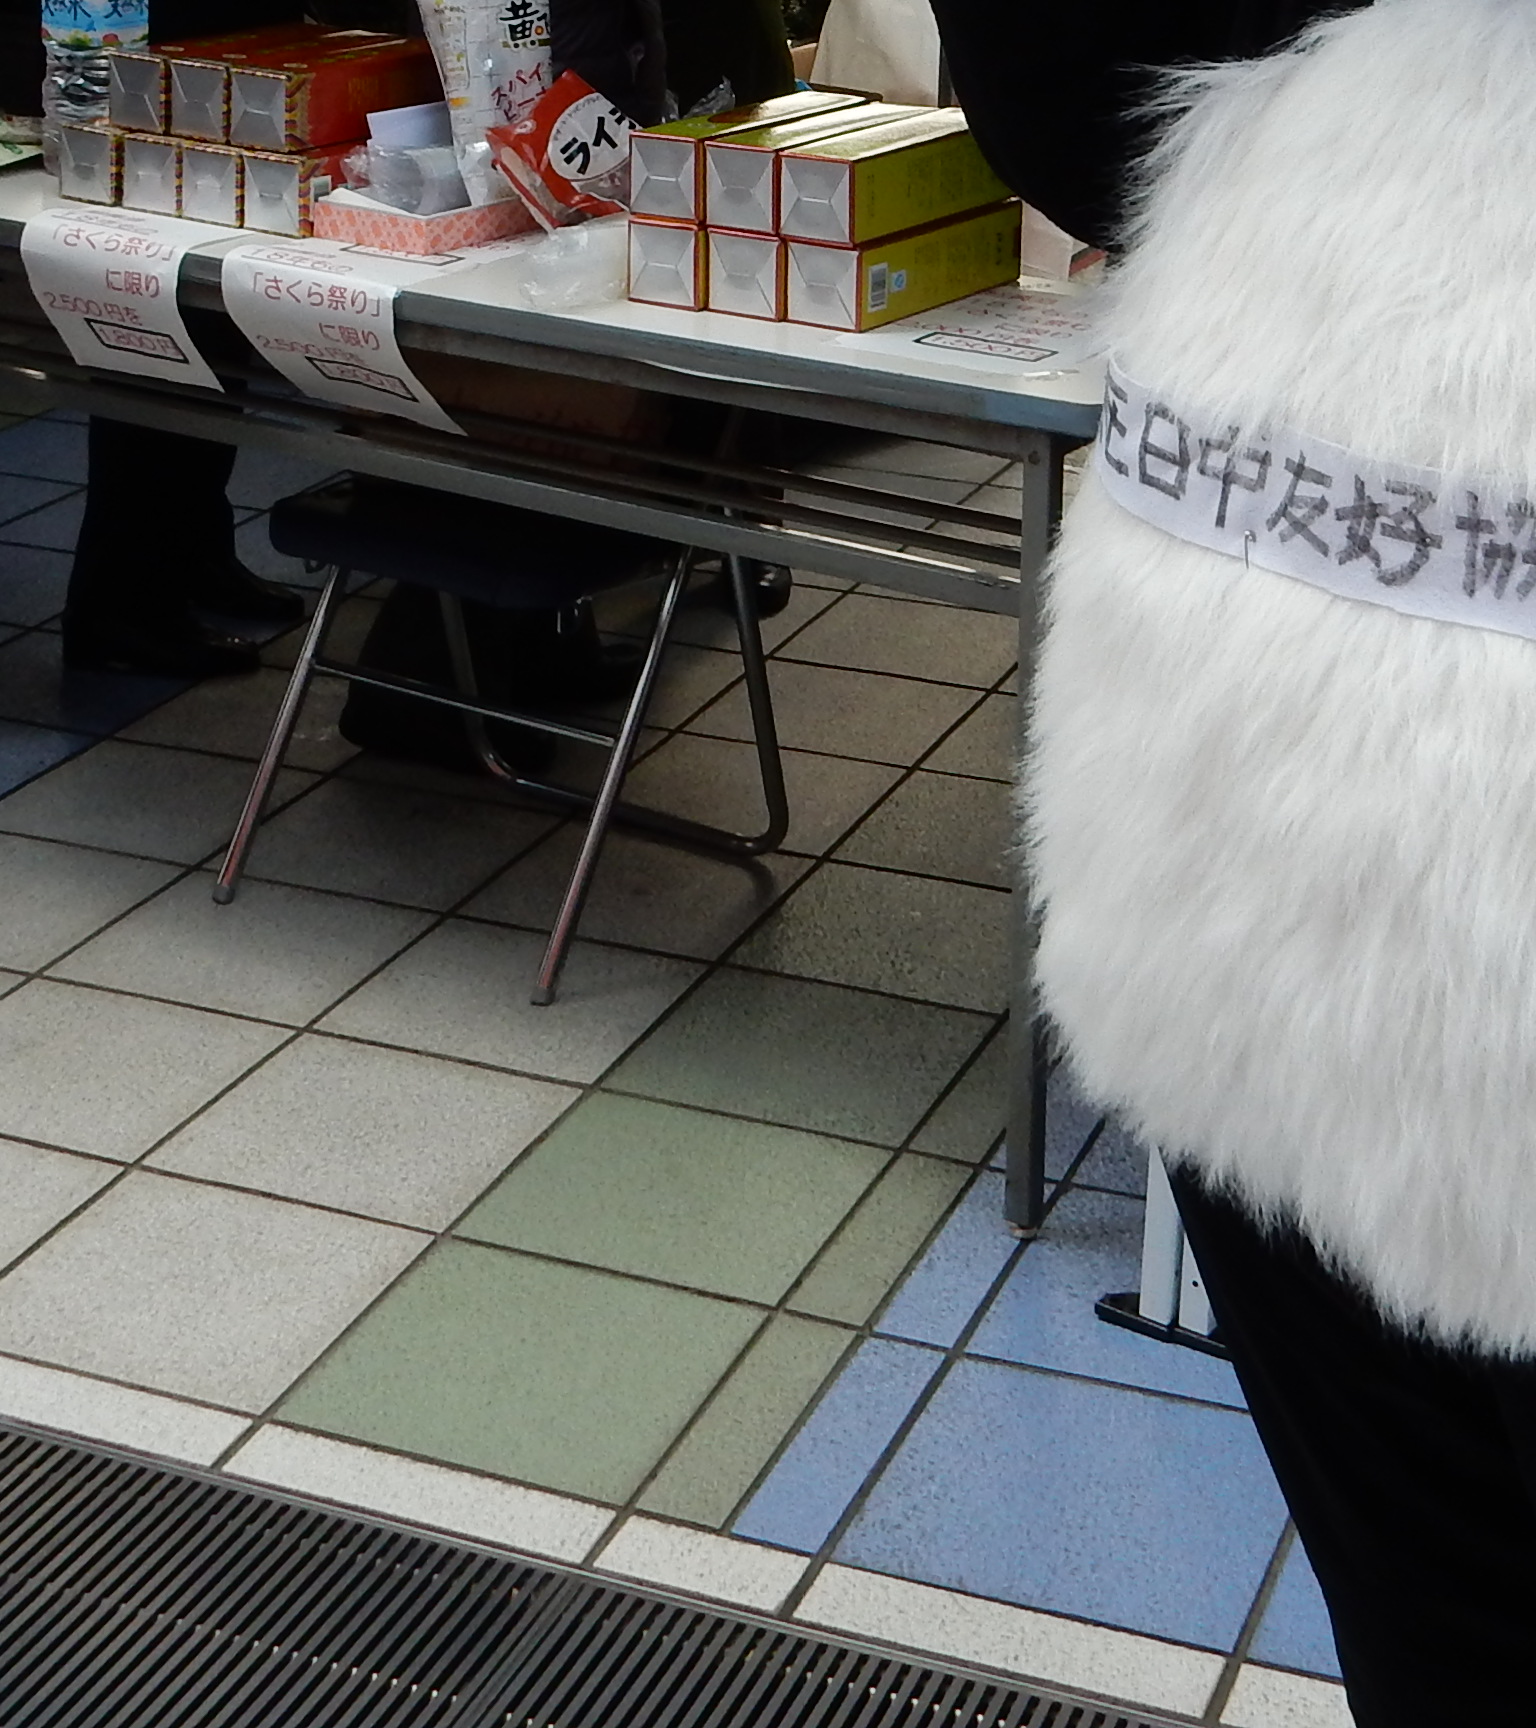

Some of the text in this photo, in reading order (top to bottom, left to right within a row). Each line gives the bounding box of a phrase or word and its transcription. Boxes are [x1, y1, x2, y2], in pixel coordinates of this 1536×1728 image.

[492, 58, 553, 108] スパイ
[52, 223, 176, 261] 「さくら祭り」
[105, 269, 161, 299] に限り
[251, 272, 381, 317] 「さくら祭り」
[319, 322, 381, 351] に限り
